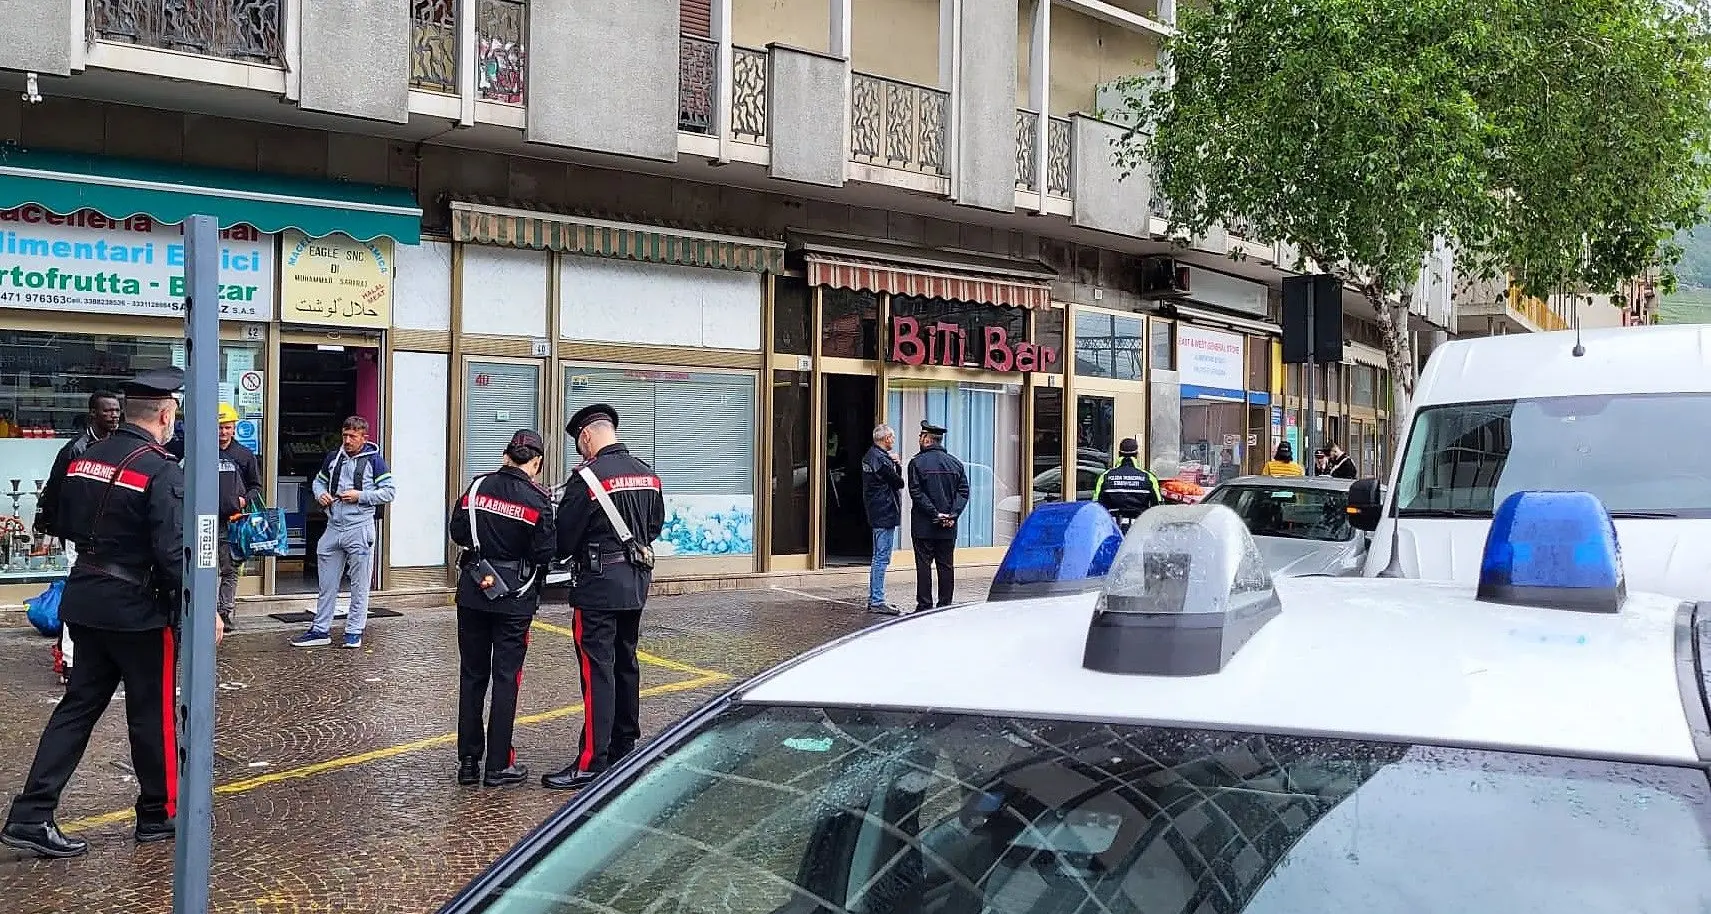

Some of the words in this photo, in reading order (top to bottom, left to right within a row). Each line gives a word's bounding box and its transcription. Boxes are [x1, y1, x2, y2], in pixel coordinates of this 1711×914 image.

[309, 245, 339, 258] EAGLE
[331, 264, 339, 274] DI
[170, 275, 258, 301] Bzar
[25, 293, 66, 304] 976363
[247, 327, 258, 337] 42
[537, 342, 546, 353] 40
[984, 326, 1056, 372] Bar
[473, 496, 525, 518] ARABINIERI
